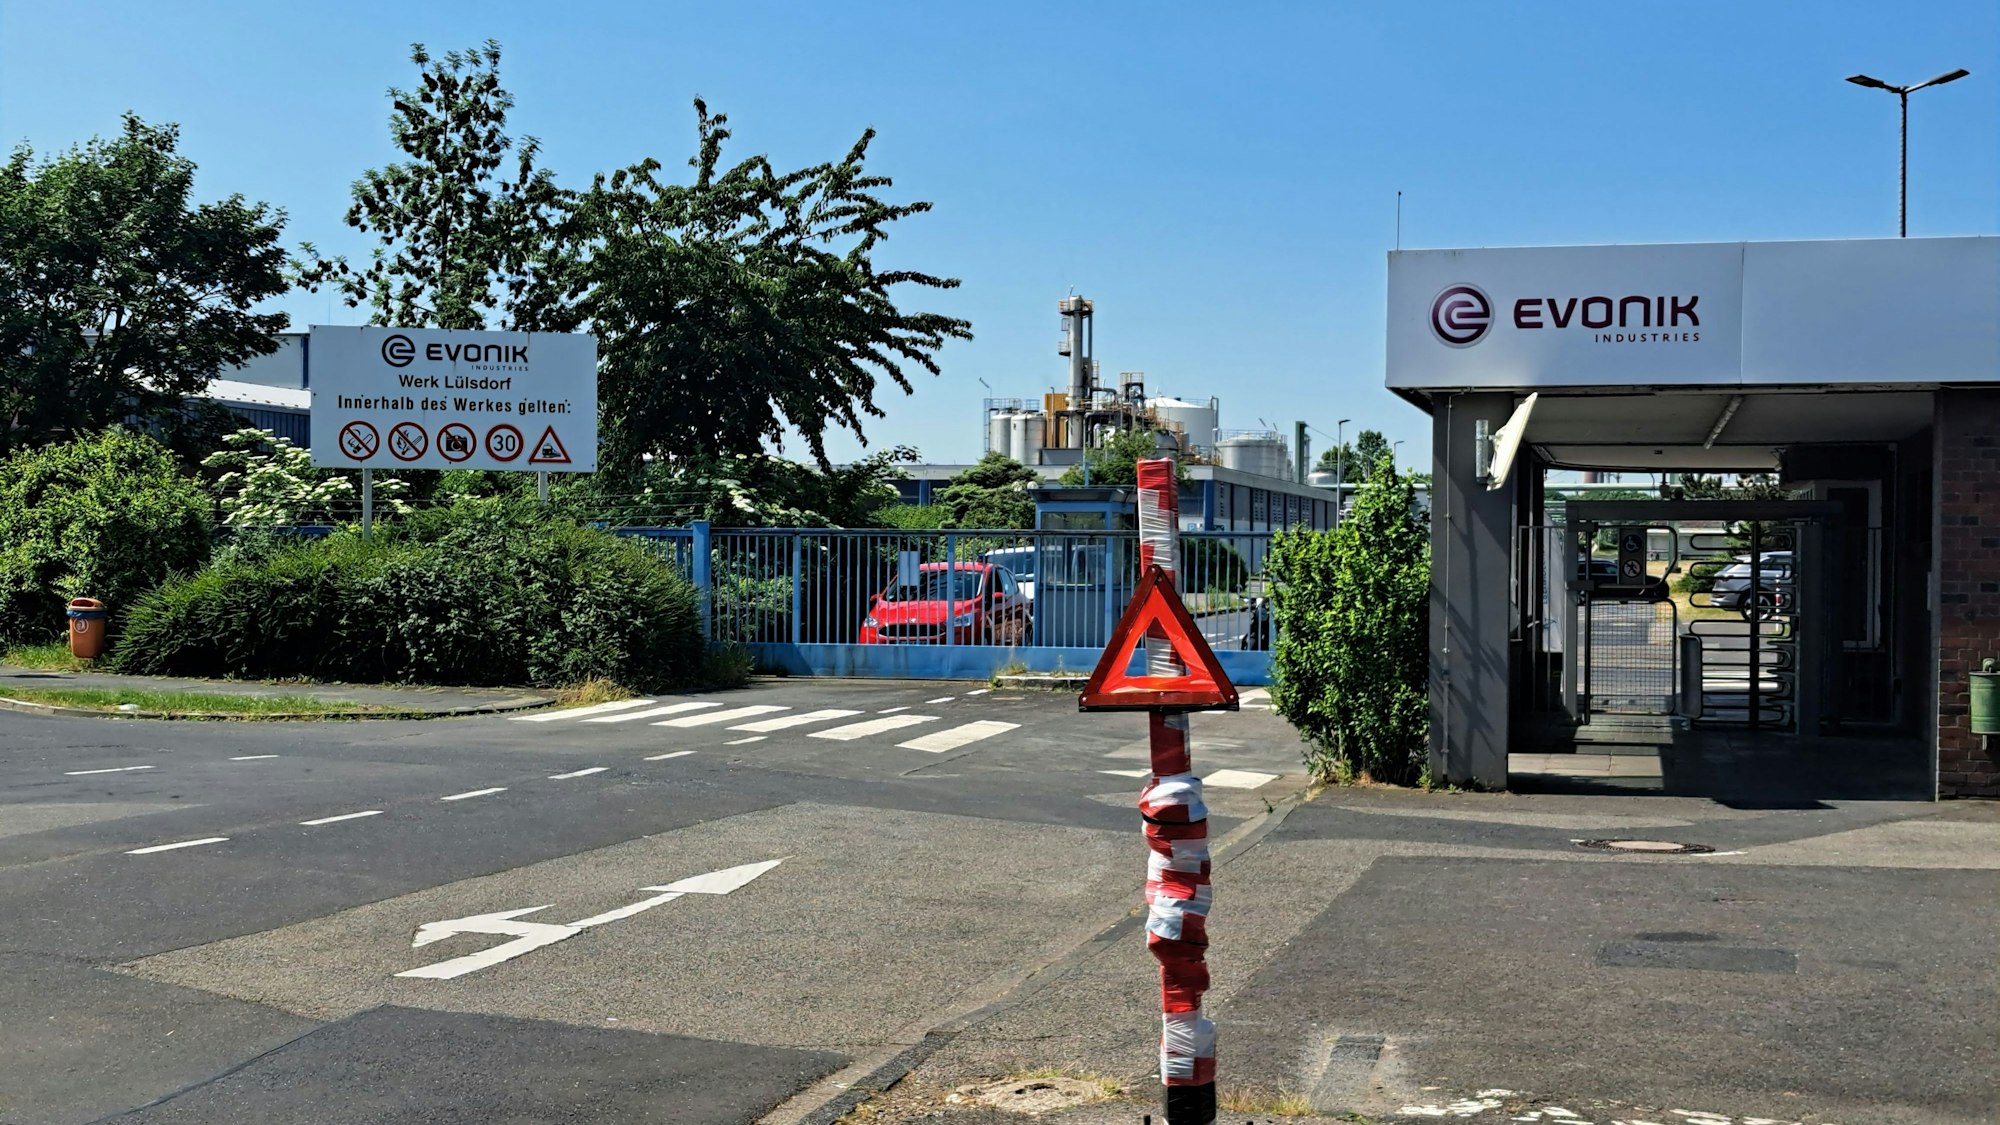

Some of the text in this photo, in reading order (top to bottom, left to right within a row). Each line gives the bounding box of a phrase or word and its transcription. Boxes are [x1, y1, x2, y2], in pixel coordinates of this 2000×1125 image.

[1513, 295, 1700, 329] EVONIK
[1595, 332, 1700, 343] INDUSTRIES
[426, 343, 529, 363] EVONIK
[398, 374, 512, 390] Werk Lülsdorf
[338, 395, 571, 415] Innerhalb des Werkes gelten:
[493, 434, 516, 452] 30
